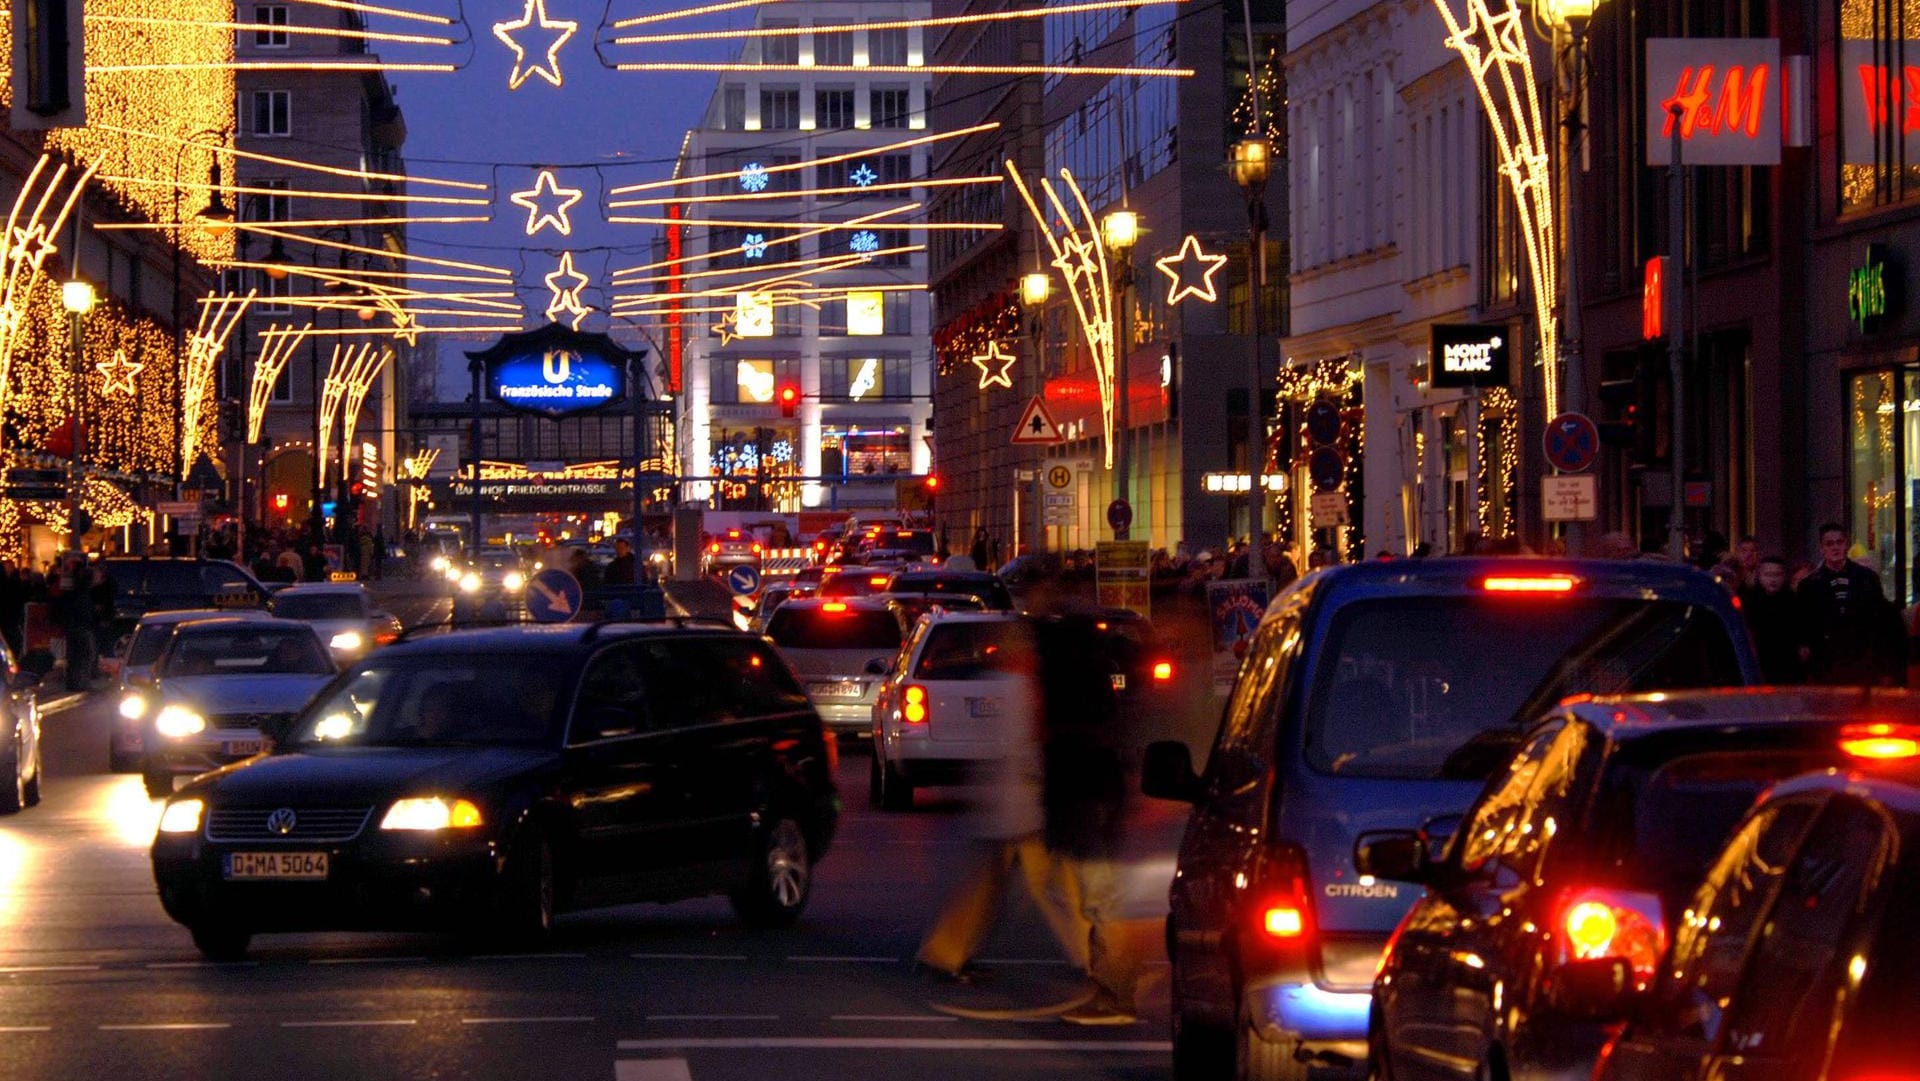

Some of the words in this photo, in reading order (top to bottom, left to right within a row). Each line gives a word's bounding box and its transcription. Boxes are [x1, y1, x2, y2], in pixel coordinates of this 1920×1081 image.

[1661, 65, 1768, 139] H&M
[1444, 343, 1491, 357] MONT
[543, 352, 570, 384] U
[1444, 357, 1491, 371] BLANC
[500, 384, 574, 397] Französische
[576, 384, 613, 397] Straße
[455, 485, 504, 495] BAHOF
[507, 484, 606, 495] FRIEDRICHSTRASSE
[281, 855, 324, 874] 5064
